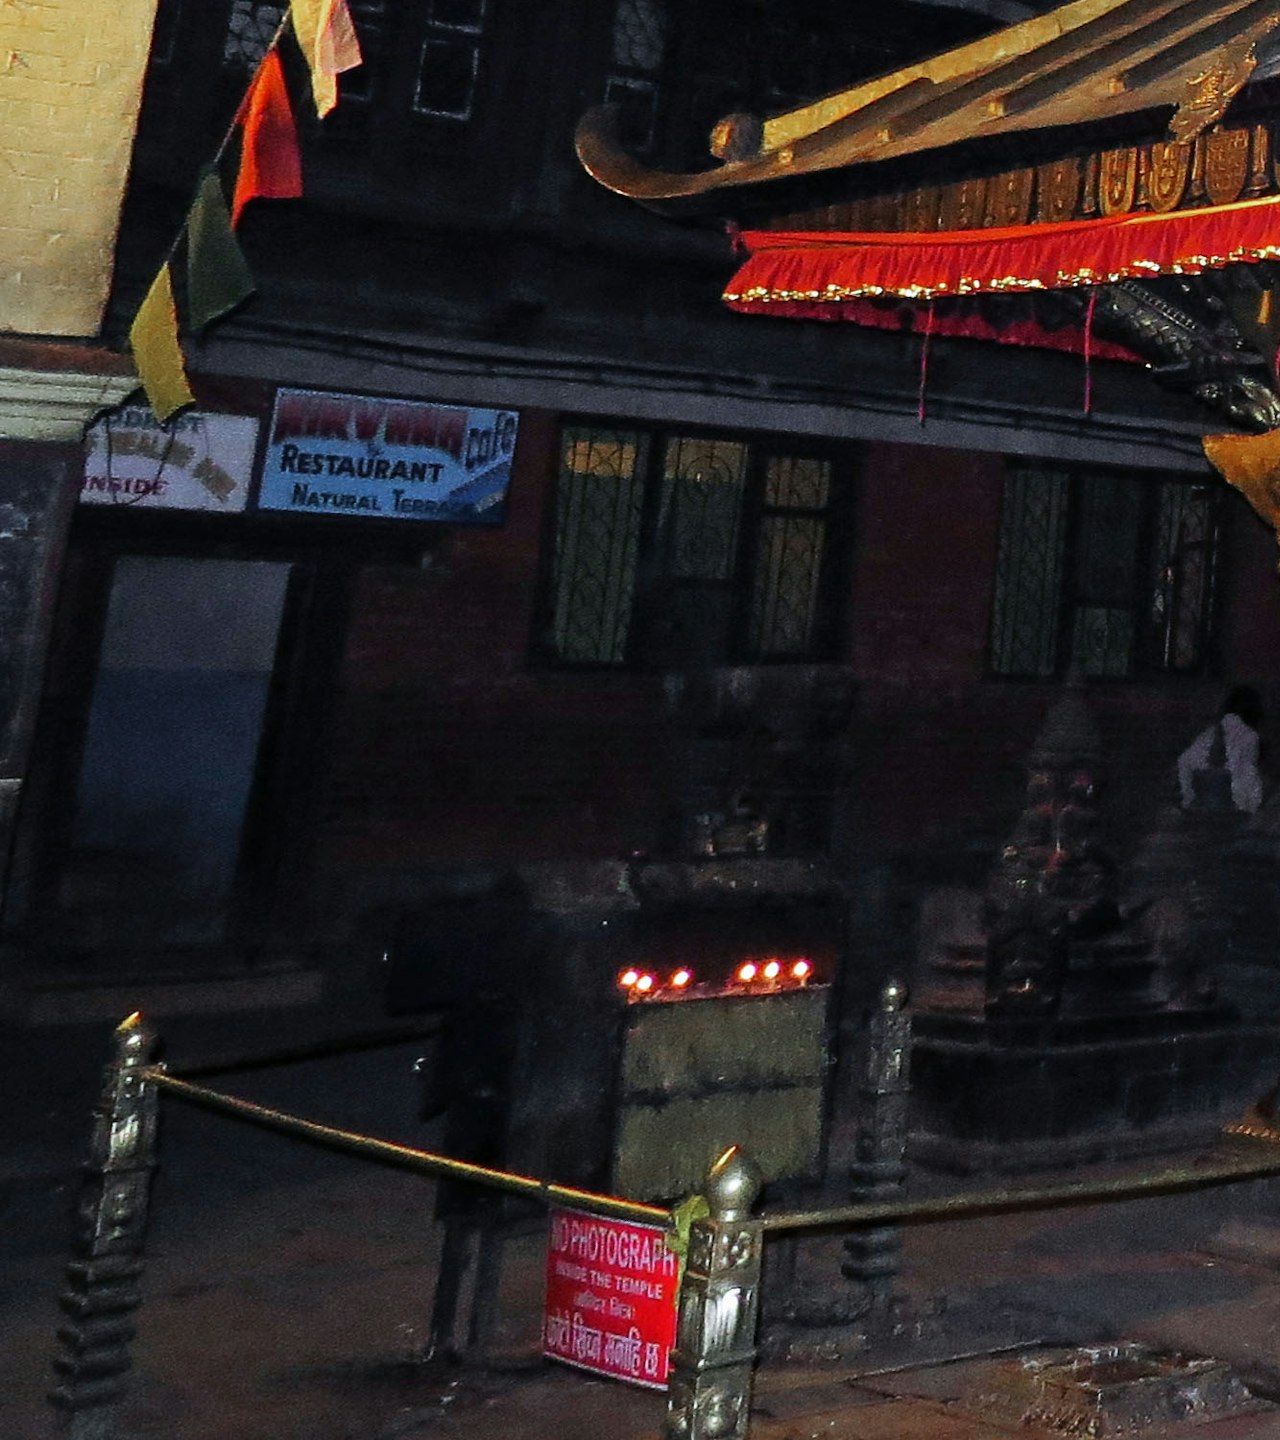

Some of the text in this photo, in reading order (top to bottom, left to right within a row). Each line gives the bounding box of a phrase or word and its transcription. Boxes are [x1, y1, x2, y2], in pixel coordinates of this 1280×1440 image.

[571, 1219, 675, 1277] PHOTOGRAPH
[589, 1269, 612, 1290] THE
[614, 1274, 664, 1299] TEMPLE
